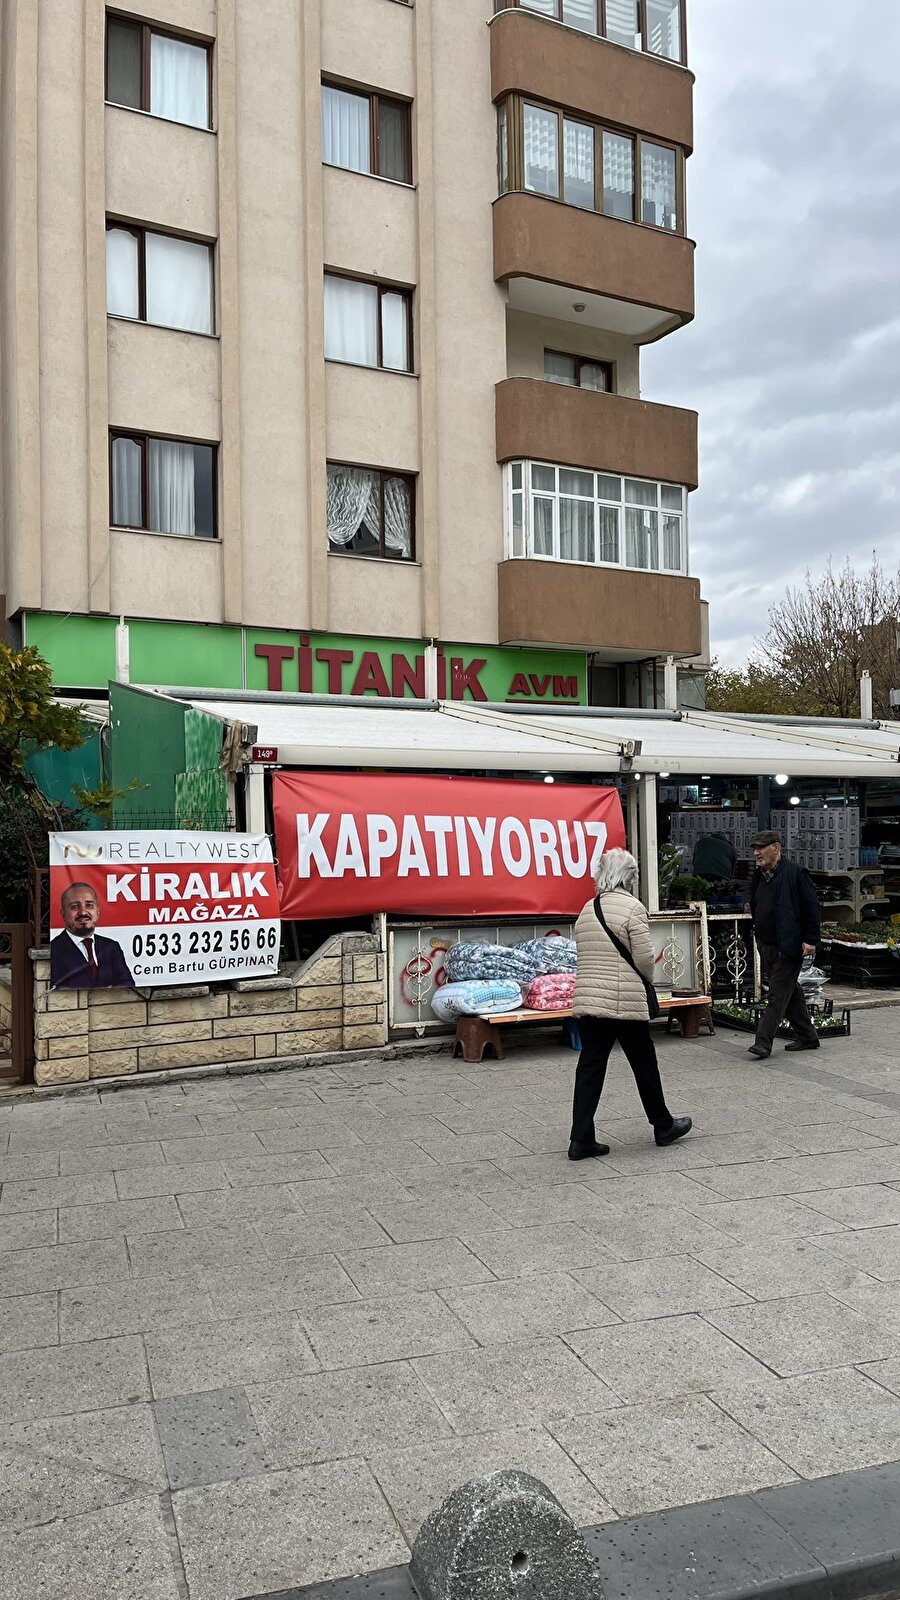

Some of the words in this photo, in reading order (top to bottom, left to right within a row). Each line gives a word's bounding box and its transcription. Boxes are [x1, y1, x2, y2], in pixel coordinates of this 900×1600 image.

[255, 636, 488, 701] TİTANİK
[508, 673, 577, 697] AVM
[296, 813, 608, 879] KAPATIYORUZ
[107, 867, 270, 903] KİRALIK
[148, 903, 259, 923] MAĞAZA
[132, 932, 182, 957] 0533
[189, 930, 223, 954] 232
[229, 928, 250, 951] 56
[257, 927, 277, 949] 66
[133, 964, 164, 976] Cem
[168, 961, 204, 974] Bartu
[209, 954, 274, 970] GÜRPINAR
